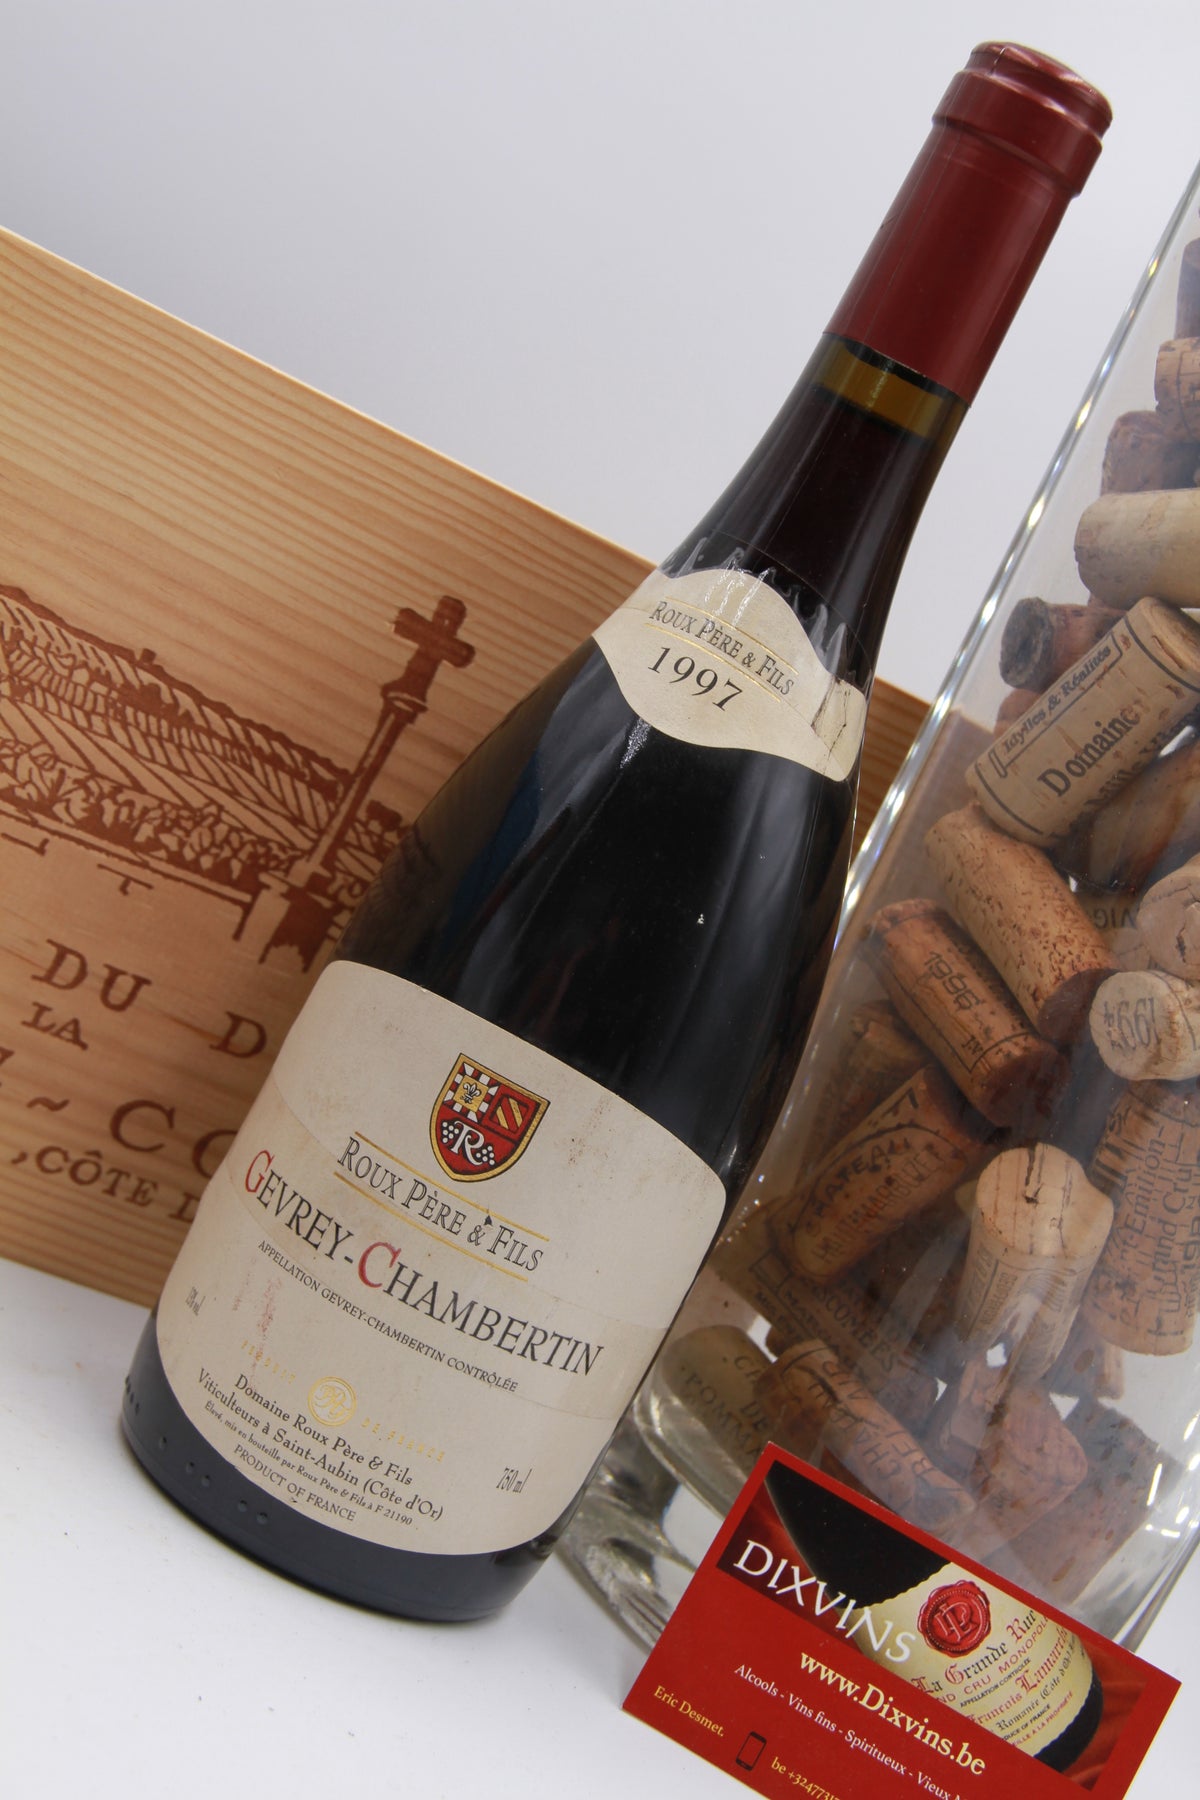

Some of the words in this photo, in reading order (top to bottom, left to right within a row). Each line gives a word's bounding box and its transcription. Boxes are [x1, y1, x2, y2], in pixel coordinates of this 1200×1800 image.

[647, 646, 743, 712] 1997
[742, 651, 756, 668] &
[1047, 695, 1061, 711] &
[1037, 703, 1140, 796] Domaine
[31, 939, 152, 1012] DU
[21, 1001, 88, 1050] LA
[454, 1120, 485, 1166] R
[1162, 1166, 1194, 1216] Cru
[467, 1224, 487, 1247] &
[258, 1239, 321, 1292] APPELLATION
[321, 1287, 446, 1363] GEVREY-CHAMBERTIN
[447, 1357, 519, 1392] CONTRÔLÉE
[198, 1367, 260, 1428] Viticulteurs
[262, 1422, 270, 1435] à
[273, 1428, 359, 1486] Saint-Aubin
[363, 1478, 402, 1505] (Côte
[405, 1494, 443, 1521] d'Or)
[235, 1374, 290, 1421] Domaine
[293, 1414, 329, 1445] Roux
[332, 1436, 365, 1464] Père
[368, 1456, 383, 1470] &
[384, 1462, 413, 1485] Fils
[234, 1444, 287, 1486] PRODUCT
[287, 1482, 306, 1498] OF
[306, 1492, 357, 1521] FRANCE
[248, 1433, 280, 1461] bouteille
[281, 1458, 296, 1470] par
[297, 1465, 318, 1483] Roux
[320, 1478, 338, 1494] Père
[340, 1488, 349, 1497] &
[349, 1493, 366, 1507] Fils
[733, 1540, 916, 1663] DIXVINS
[944, 1643, 1009, 1685] Grande
[963, 1675, 992, 1695] CRU
[654, 1685, 678, 1709] Eric
[678, 1701, 724, 1737] Desmet.
[734, 1663, 778, 1698] Alcools
[788, 1693, 814, 1718] Vins
[814, 1711, 837, 1732] fins
[845, 1729, 906, 1776] Spiritueux
[917, 1771, 952, 1800] Vieux
[800, 1652, 986, 1776] www.Dixvins.be
[771, 1756, 787, 1774] be
